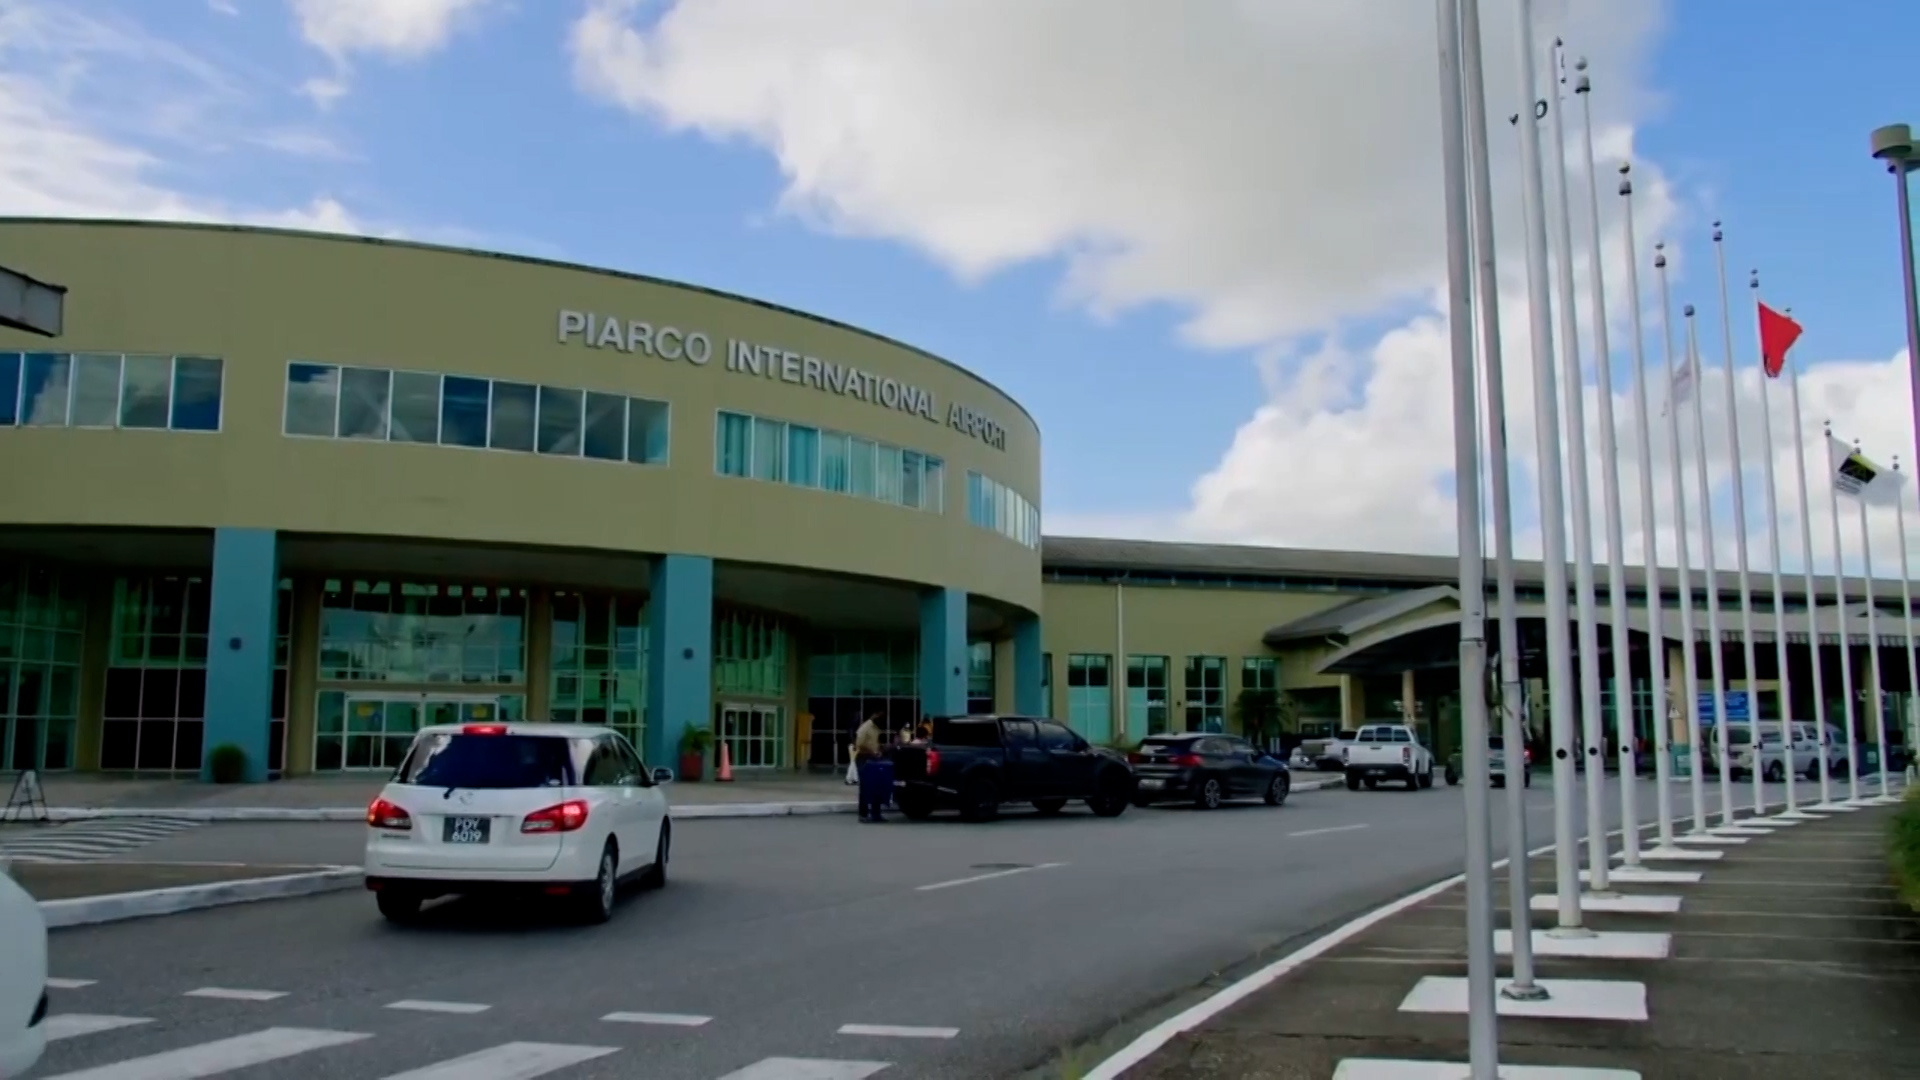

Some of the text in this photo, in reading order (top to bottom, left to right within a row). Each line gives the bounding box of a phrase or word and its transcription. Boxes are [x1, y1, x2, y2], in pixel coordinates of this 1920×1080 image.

[558, 309, 1006, 451] PIARCO INTERNATIONAL AIRPORT
